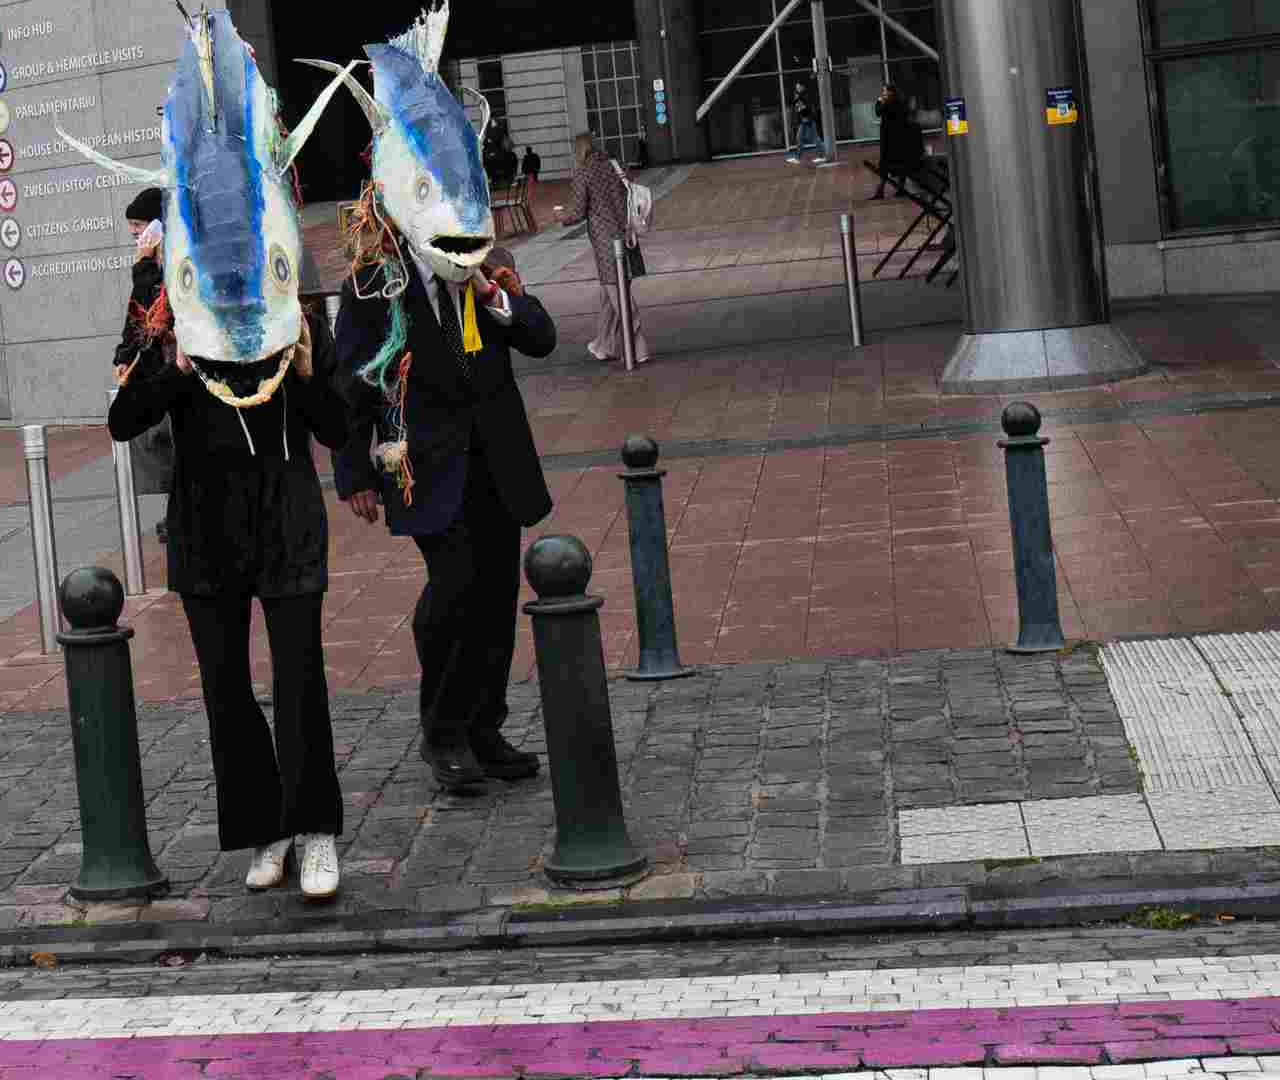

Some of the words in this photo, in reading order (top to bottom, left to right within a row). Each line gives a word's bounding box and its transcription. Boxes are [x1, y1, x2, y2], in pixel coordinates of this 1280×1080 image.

[7, 24, 31, 40] INFO
[31, 21, 53, 36] HUB
[11, 62, 46, 81] GROUP
[55, 50, 111, 74] HEMICYCLE
[111, 44, 144, 62] VISITS
[20, 141, 51, 159] HOUSE
[56, 177, 95, 193] VISITOR
[72, 216, 113, 233] GARDEN
